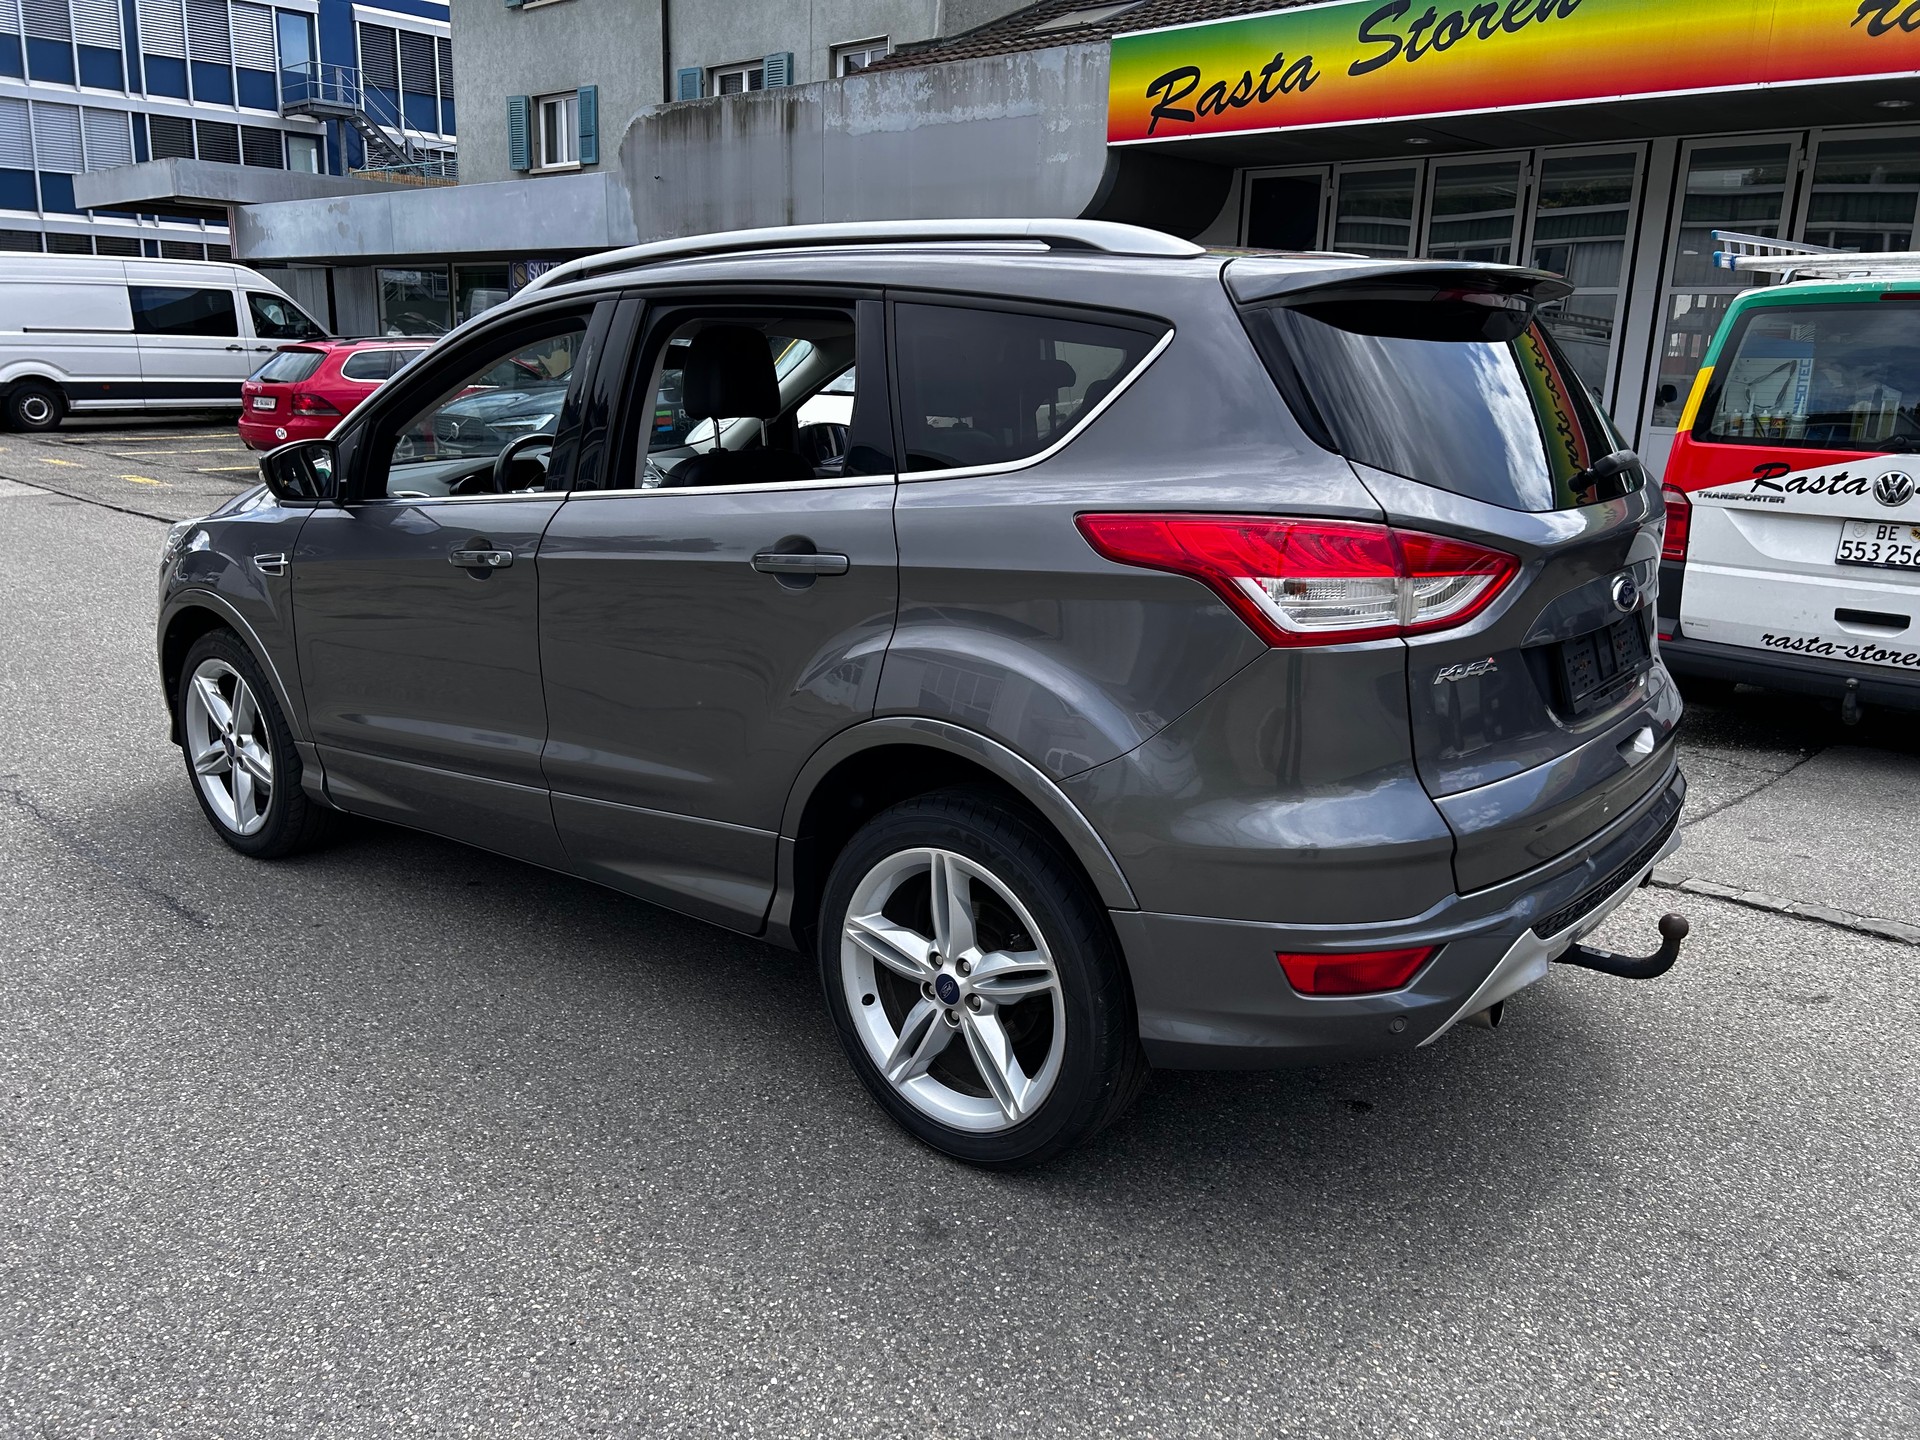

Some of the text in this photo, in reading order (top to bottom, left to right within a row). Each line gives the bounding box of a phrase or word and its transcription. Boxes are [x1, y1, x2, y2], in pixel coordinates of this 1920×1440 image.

[1146, 0, 1582, 135] Rasta Storen
[529, 262, 561, 281] SKIZ
[277, 429, 286, 437] CH
[1750, 462, 1871, 496] Rasta
[1697, 491, 1786, 504] TRANSPORTER
[1876, 525, 1900, 541] BE
[1840, 540, 1920, 565] 553 256
[1761, 633, 1920, 666] rasta-store
